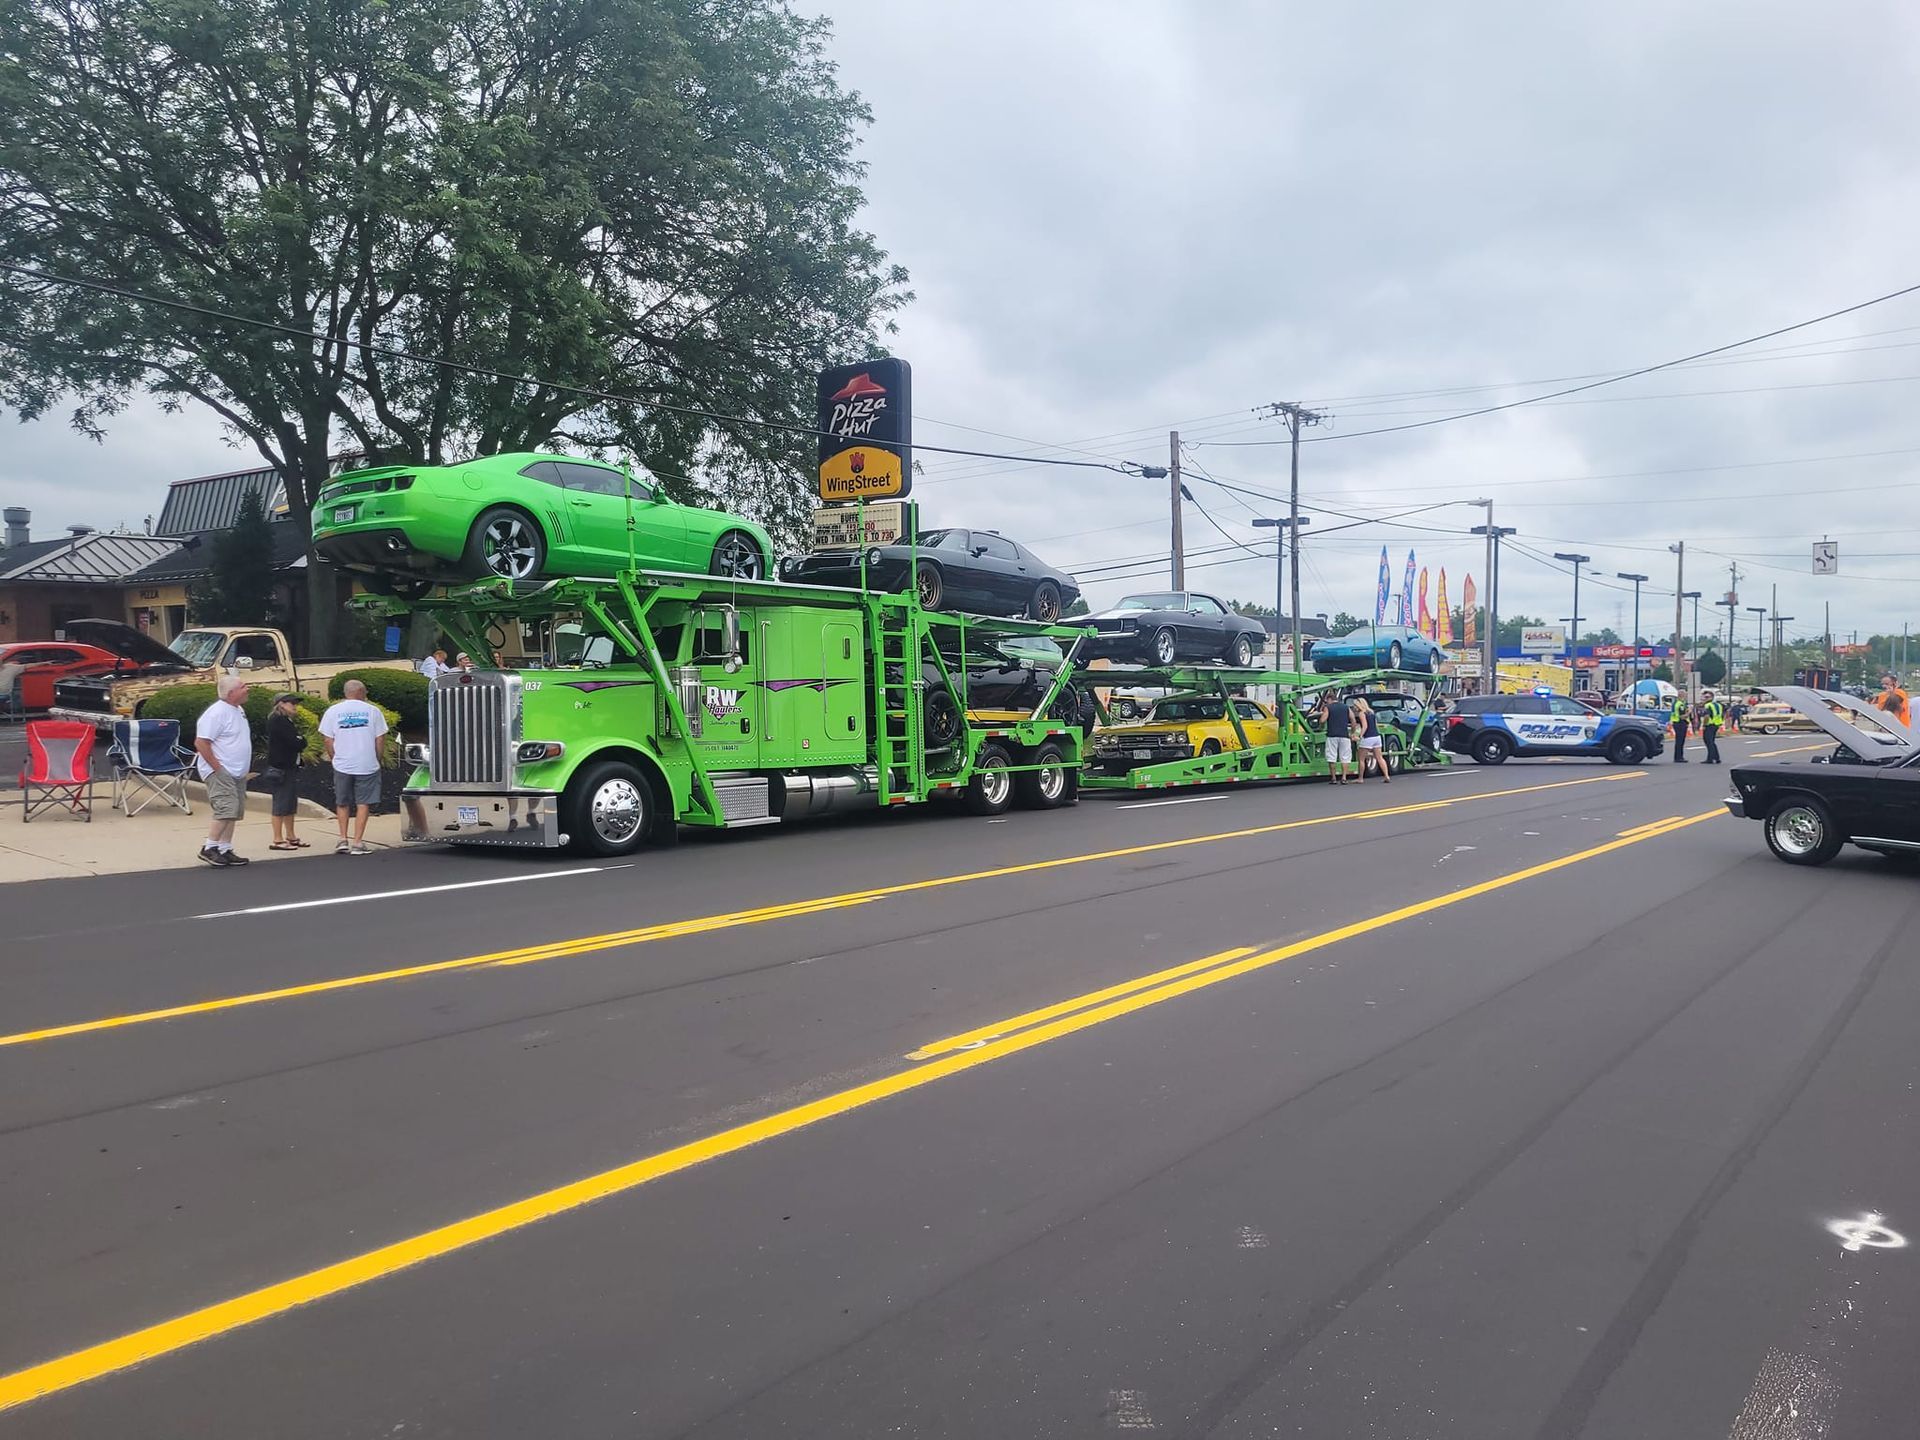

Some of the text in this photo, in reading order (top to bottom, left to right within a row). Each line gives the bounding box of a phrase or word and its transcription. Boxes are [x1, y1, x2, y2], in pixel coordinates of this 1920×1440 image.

[829, 394, 887, 433] Pizza
[838, 415, 880, 443] Hut
[826, 472, 891, 494] WingStreet
[841, 513, 860, 523] BUFFE
[832, 533, 847, 543] THRU
[871, 532, 880, 540] TO
[881, 531, 895, 541] 730
[525, 681, 542, 691] 037
[706, 686, 738, 706] RW
[707, 703, 743, 715] Haulers
[1518, 723, 1582, 735] POLICE
